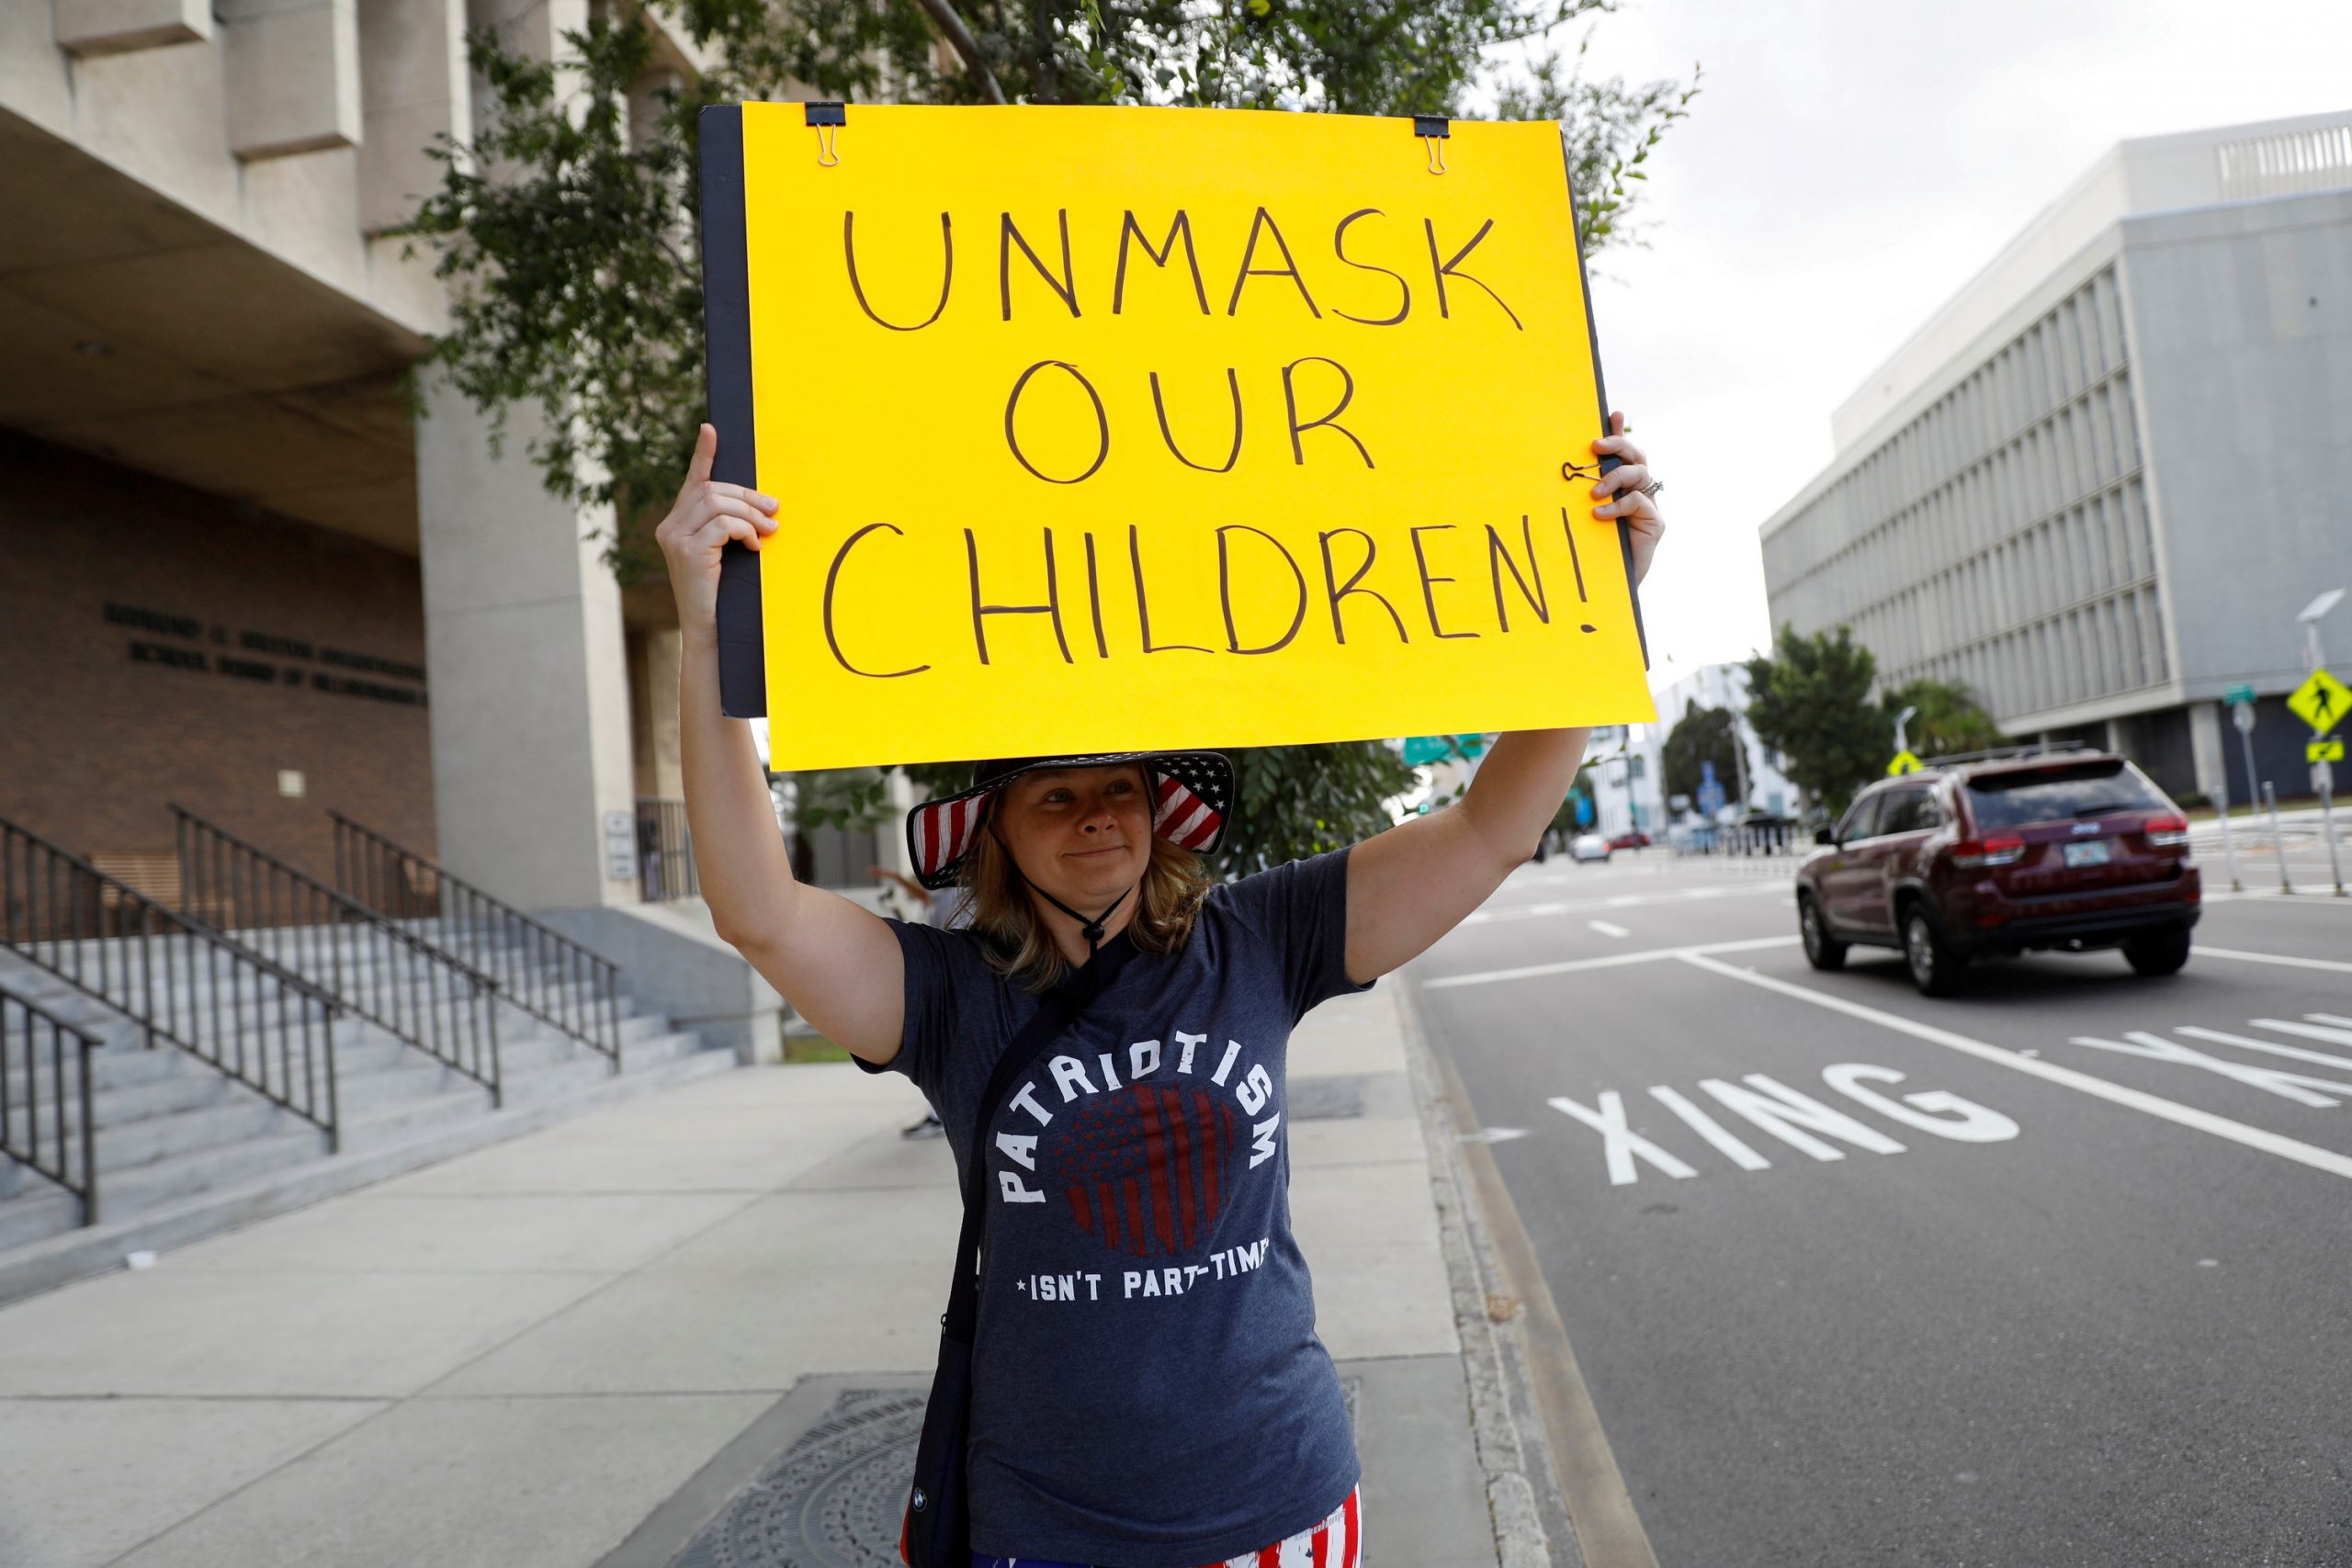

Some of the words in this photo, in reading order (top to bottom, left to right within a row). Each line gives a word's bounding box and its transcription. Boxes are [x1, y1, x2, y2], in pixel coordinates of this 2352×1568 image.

[843, 207, 1523, 332] UNMASK
[1004, 356, 1375, 484] OUR
[823, 507, 1598, 678] CHILDREN!
[995, 1030, 1281, 1203] PATRIOTISM
[1546, 1062, 2020, 1186] XING
